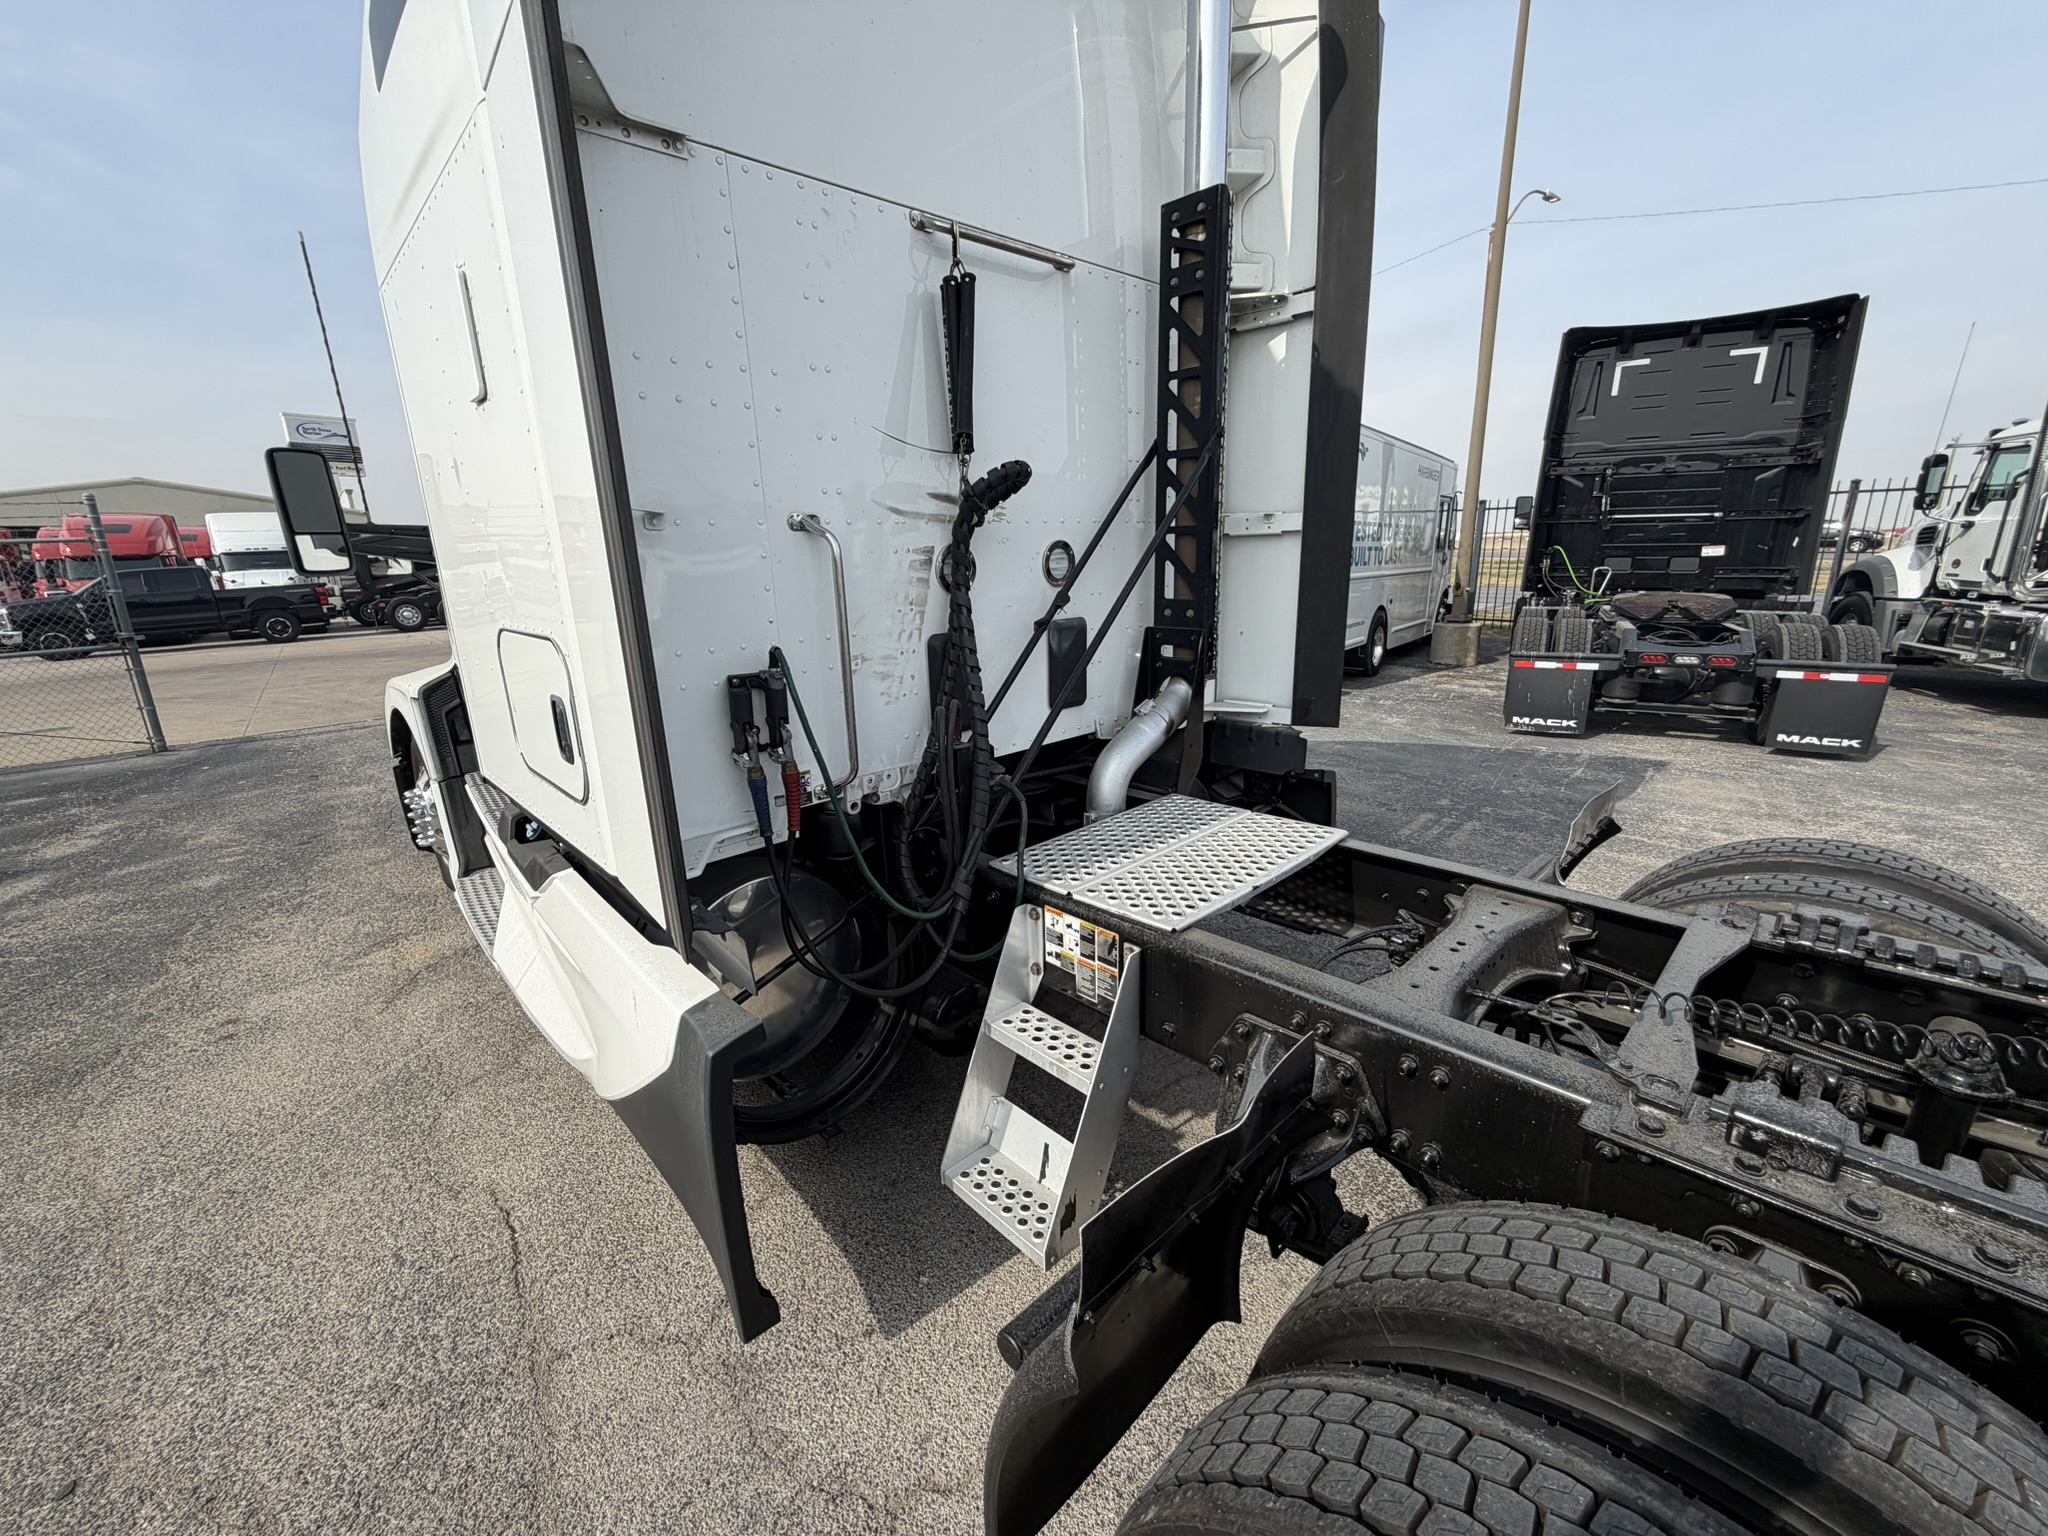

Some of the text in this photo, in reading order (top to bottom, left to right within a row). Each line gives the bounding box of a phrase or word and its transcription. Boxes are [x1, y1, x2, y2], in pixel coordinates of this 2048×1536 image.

[1383, 523, 1393, 542] TO
[1374, 546, 1383, 565] TO
[1512, 716, 1578, 728] MACK
[1776, 733, 1862, 748] MACK
